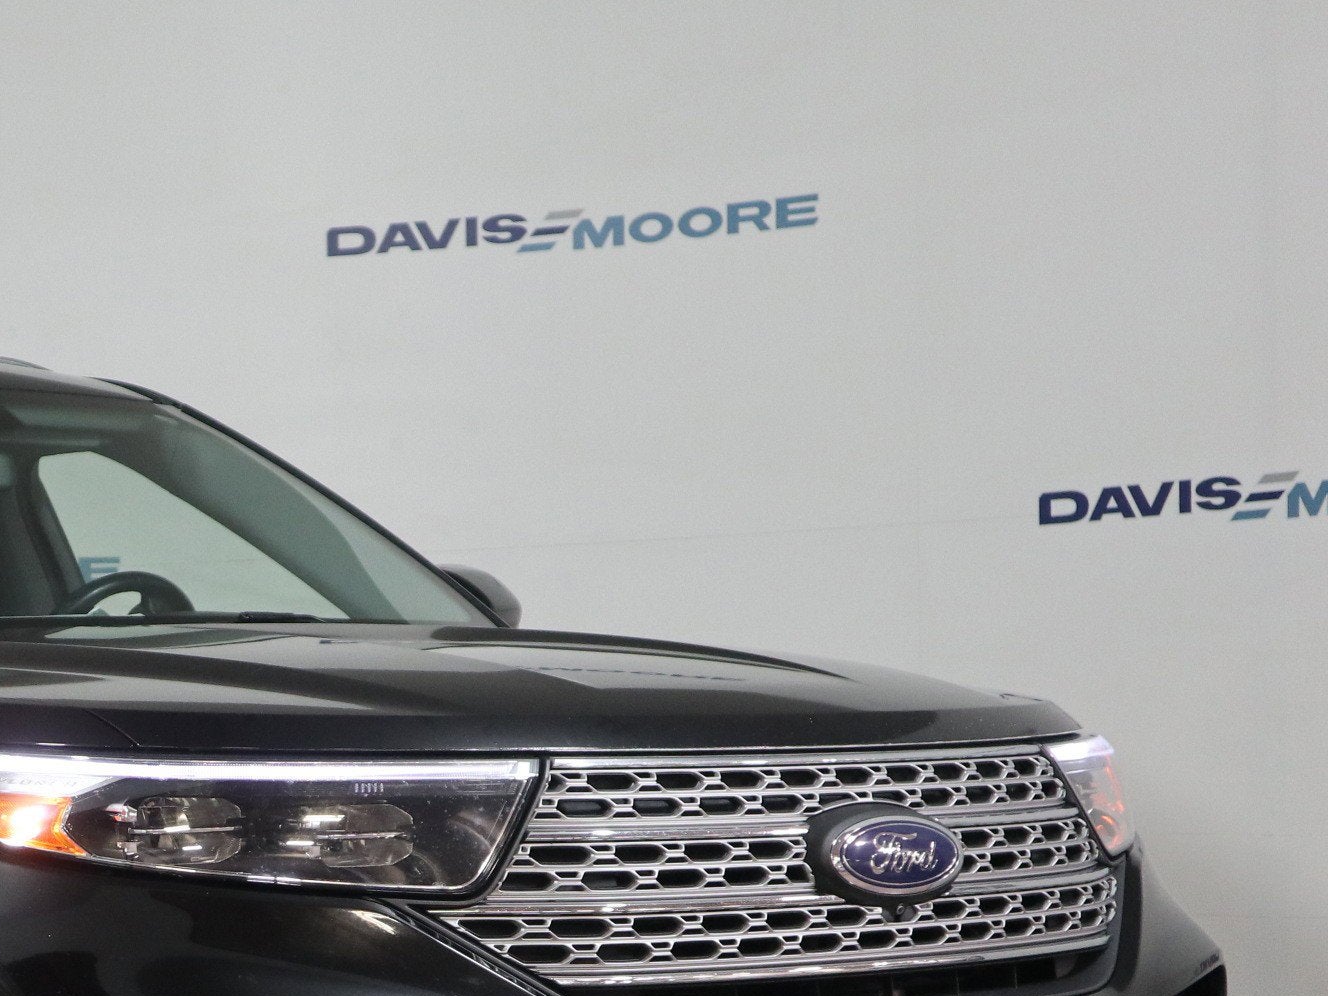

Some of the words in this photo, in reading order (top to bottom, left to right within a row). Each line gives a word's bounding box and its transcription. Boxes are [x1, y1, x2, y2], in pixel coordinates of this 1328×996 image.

[326, 214, 526, 257] DAVIS
[572, 193, 819, 250] MOORE
[1039, 476, 1242, 525] DAVIS
[871, 831, 938, 874] Ford
